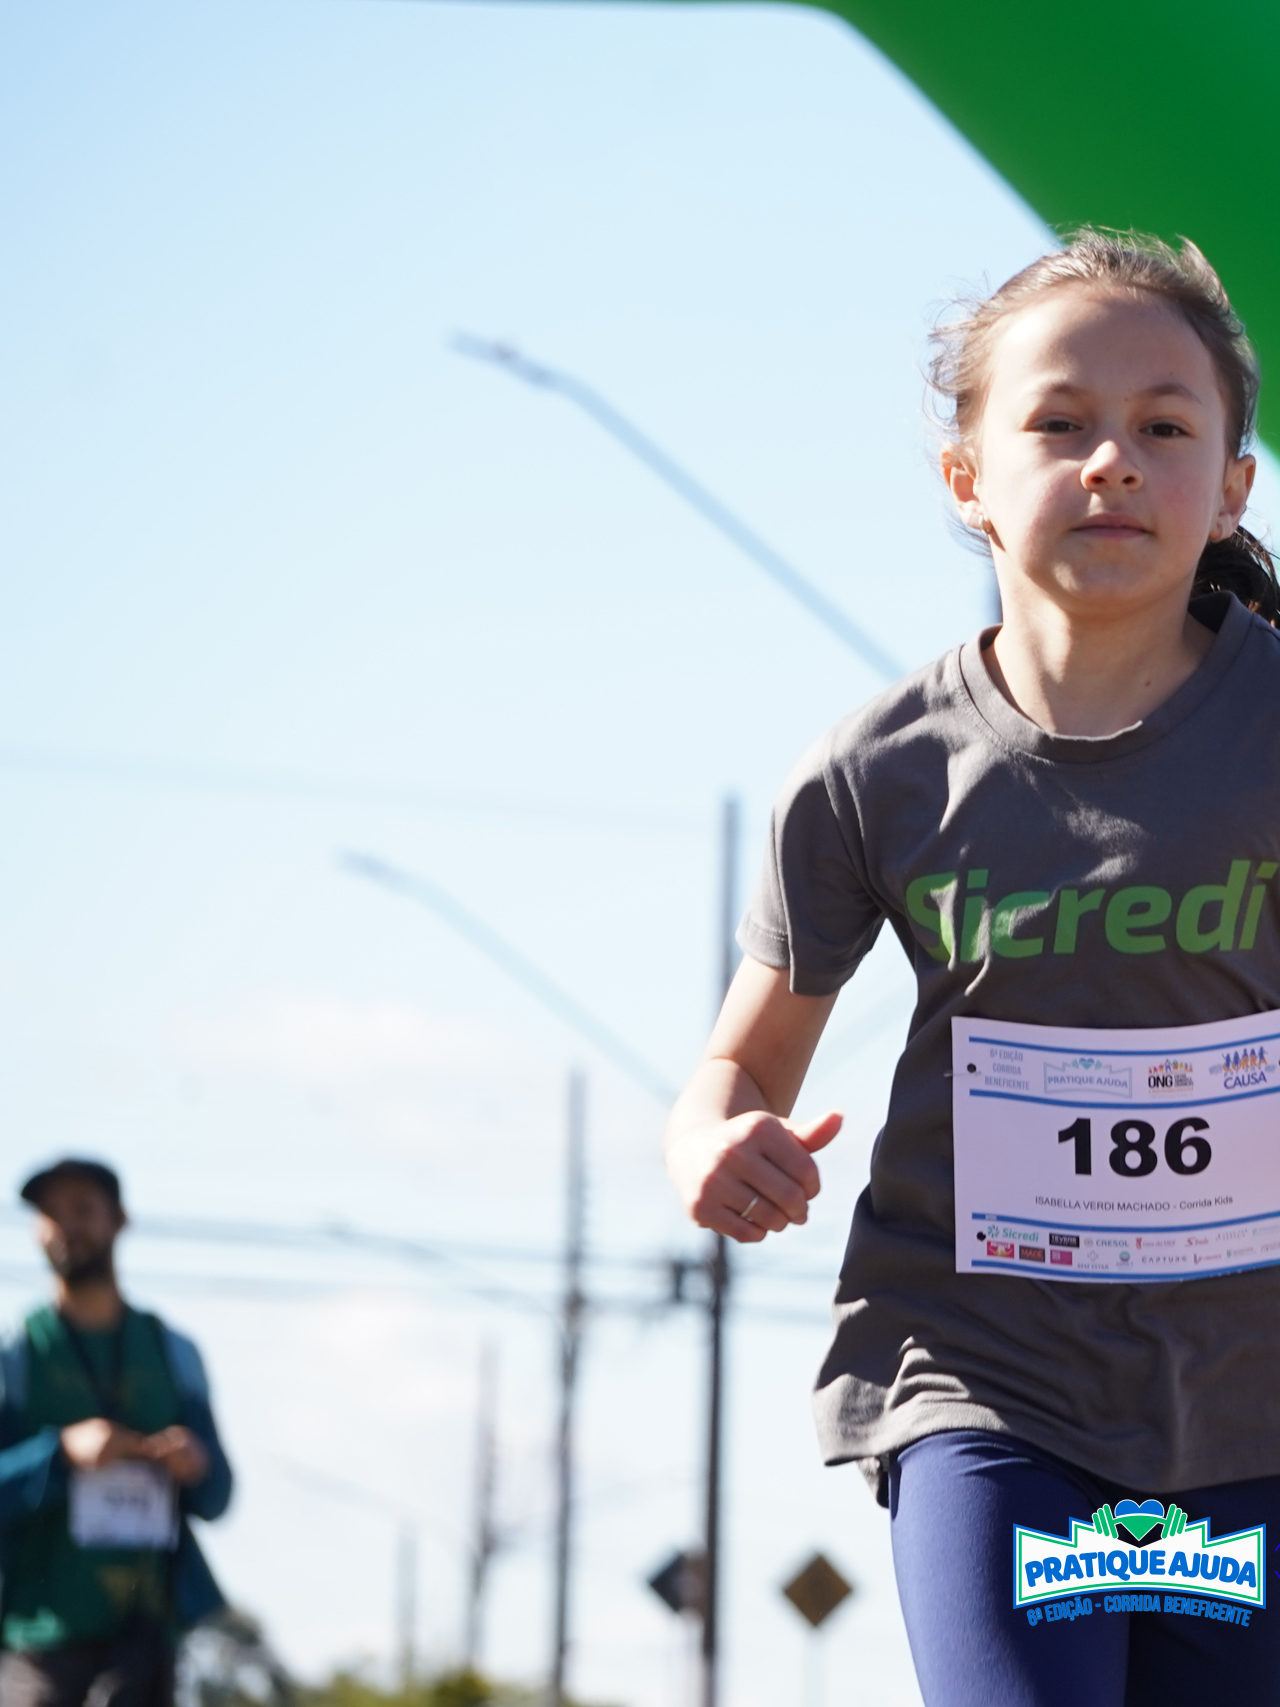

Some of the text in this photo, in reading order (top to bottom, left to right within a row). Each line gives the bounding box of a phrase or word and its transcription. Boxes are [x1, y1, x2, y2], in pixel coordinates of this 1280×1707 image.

[905, 859, 1280, 963] Sicredi
[992, 1063, 1022, 1075] CORRIDA
[1047, 1076, 1128, 1088] PRATIQUE AJUDA
[1148, 1074, 1173, 1088] ONG
[1223, 1070, 1267, 1090] CAUSA
[1058, 1116, 1212, 1178] 186
[1035, 1195, 1081, 1210] ISABELLA
[1082, 1200, 1115, 1211] VERDI
[1117, 1200, 1170, 1212] MACHADO
[1179, 1198, 1212, 1210] Corrida
[1214, 1195, 1233, 1205] Kids
[1002, 1227, 1039, 1243] Sicredi
